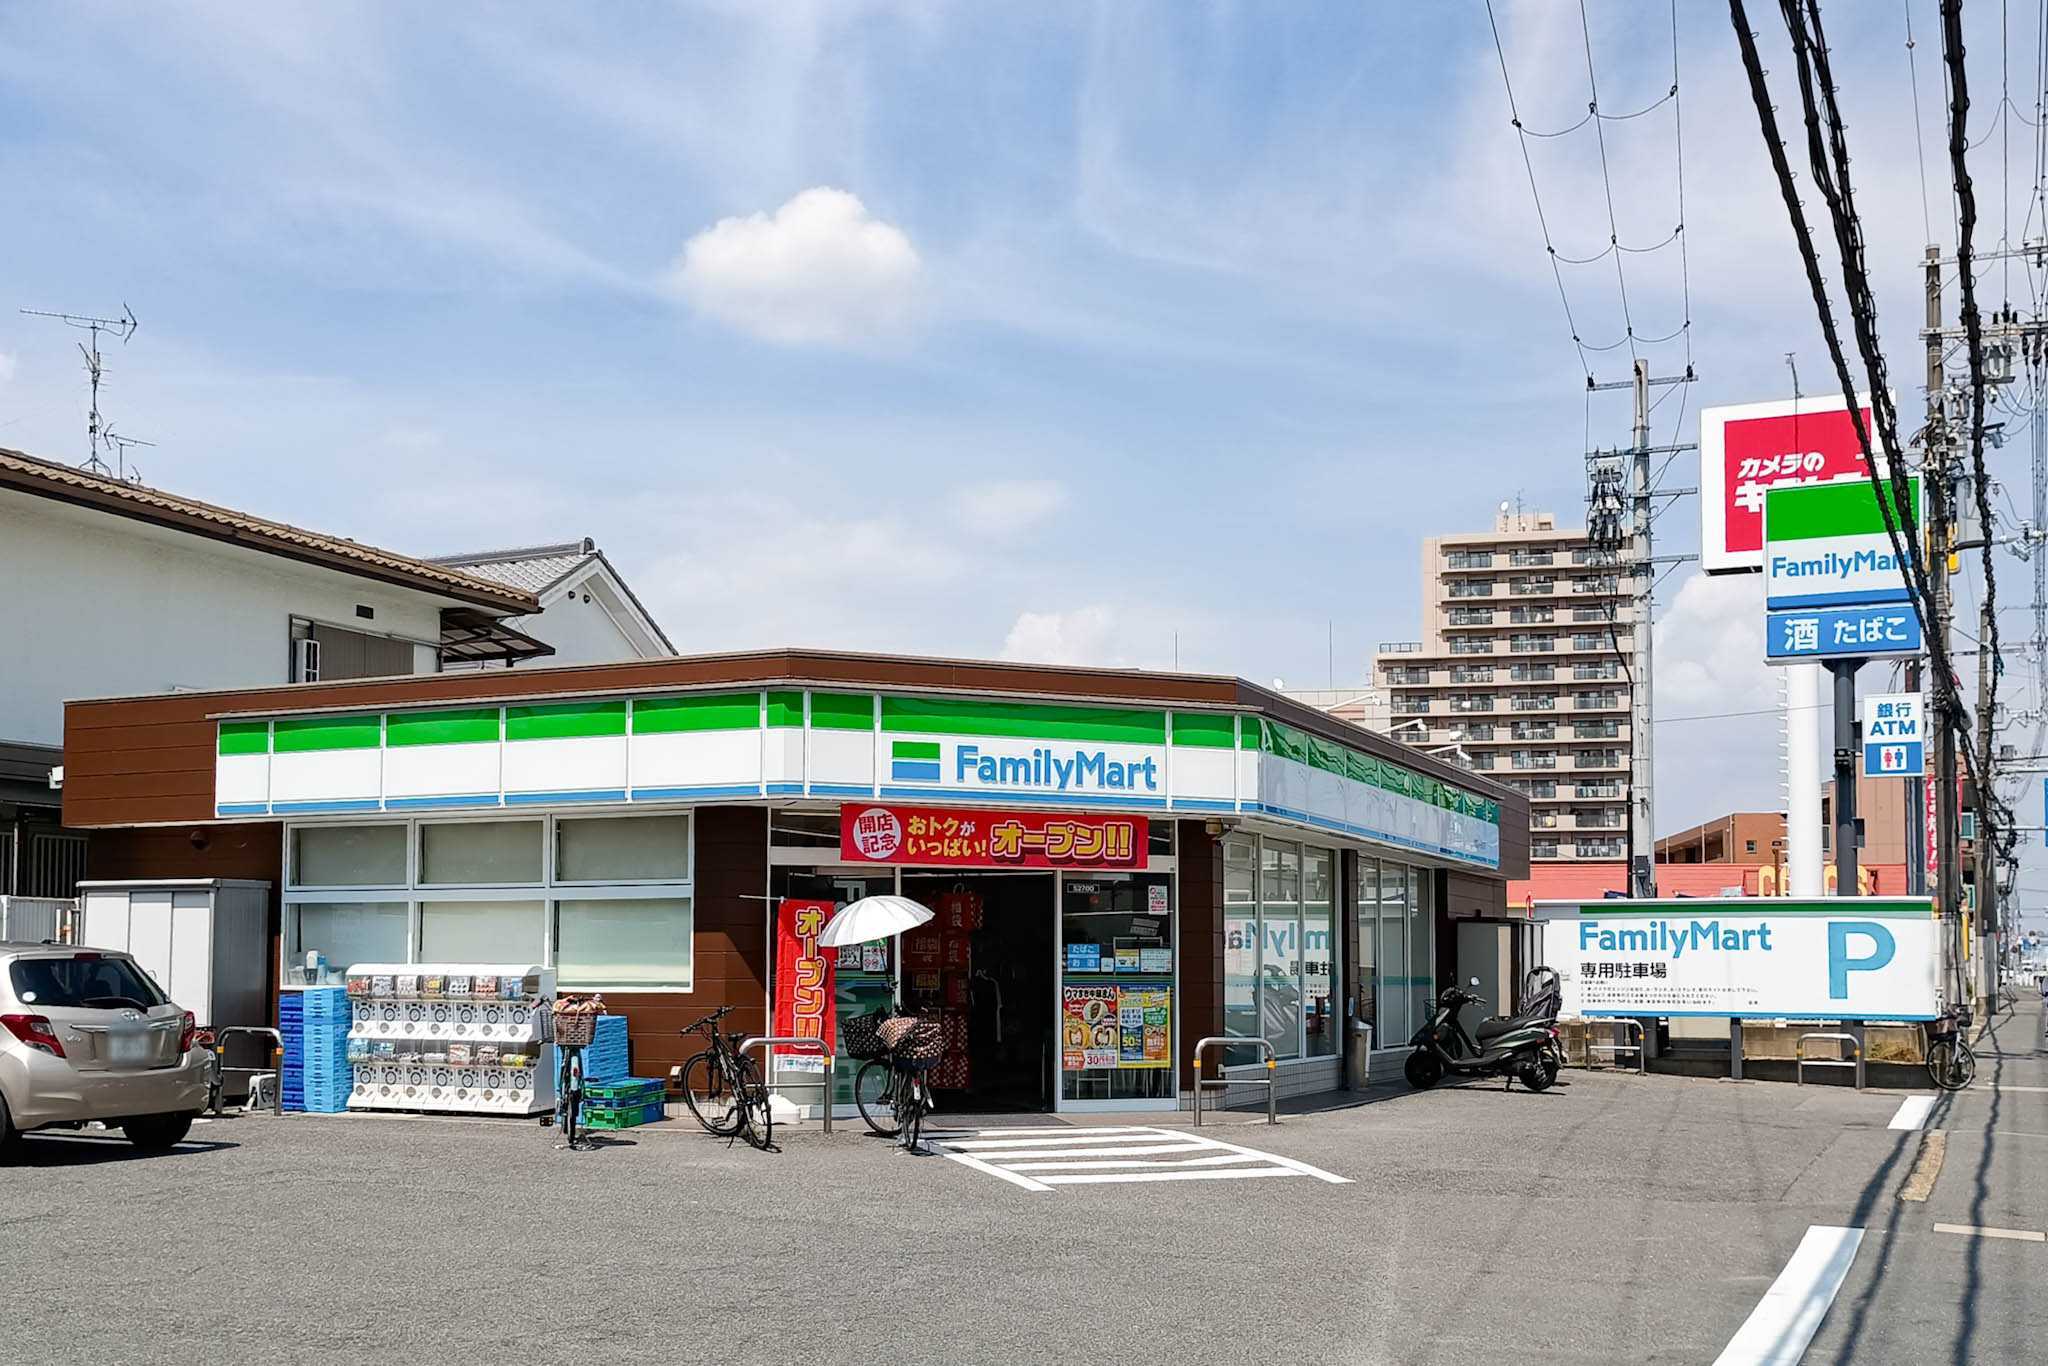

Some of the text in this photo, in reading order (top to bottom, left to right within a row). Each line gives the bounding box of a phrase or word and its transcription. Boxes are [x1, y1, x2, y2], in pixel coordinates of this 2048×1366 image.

[1737, 451, 1825, 479] カメラの
[1785, 616, 1908, 651] 酒 たばこ
[1877, 702, 1912, 719] 銀行
[1870, 720, 1916, 737] ATM
[956, 744, 1157, 791] FamilyMart
[858, 813, 894, 834] 開店
[907, 815, 976, 837] おトクが
[863, 834, 898, 854] 記念
[991, 820, 1135, 861] オープン!!
[1579, 920, 1773, 958] FamilyMart
[1580, 962, 1668, 980] 専用駐車場
[1828, 921, 1896, 1000] P
